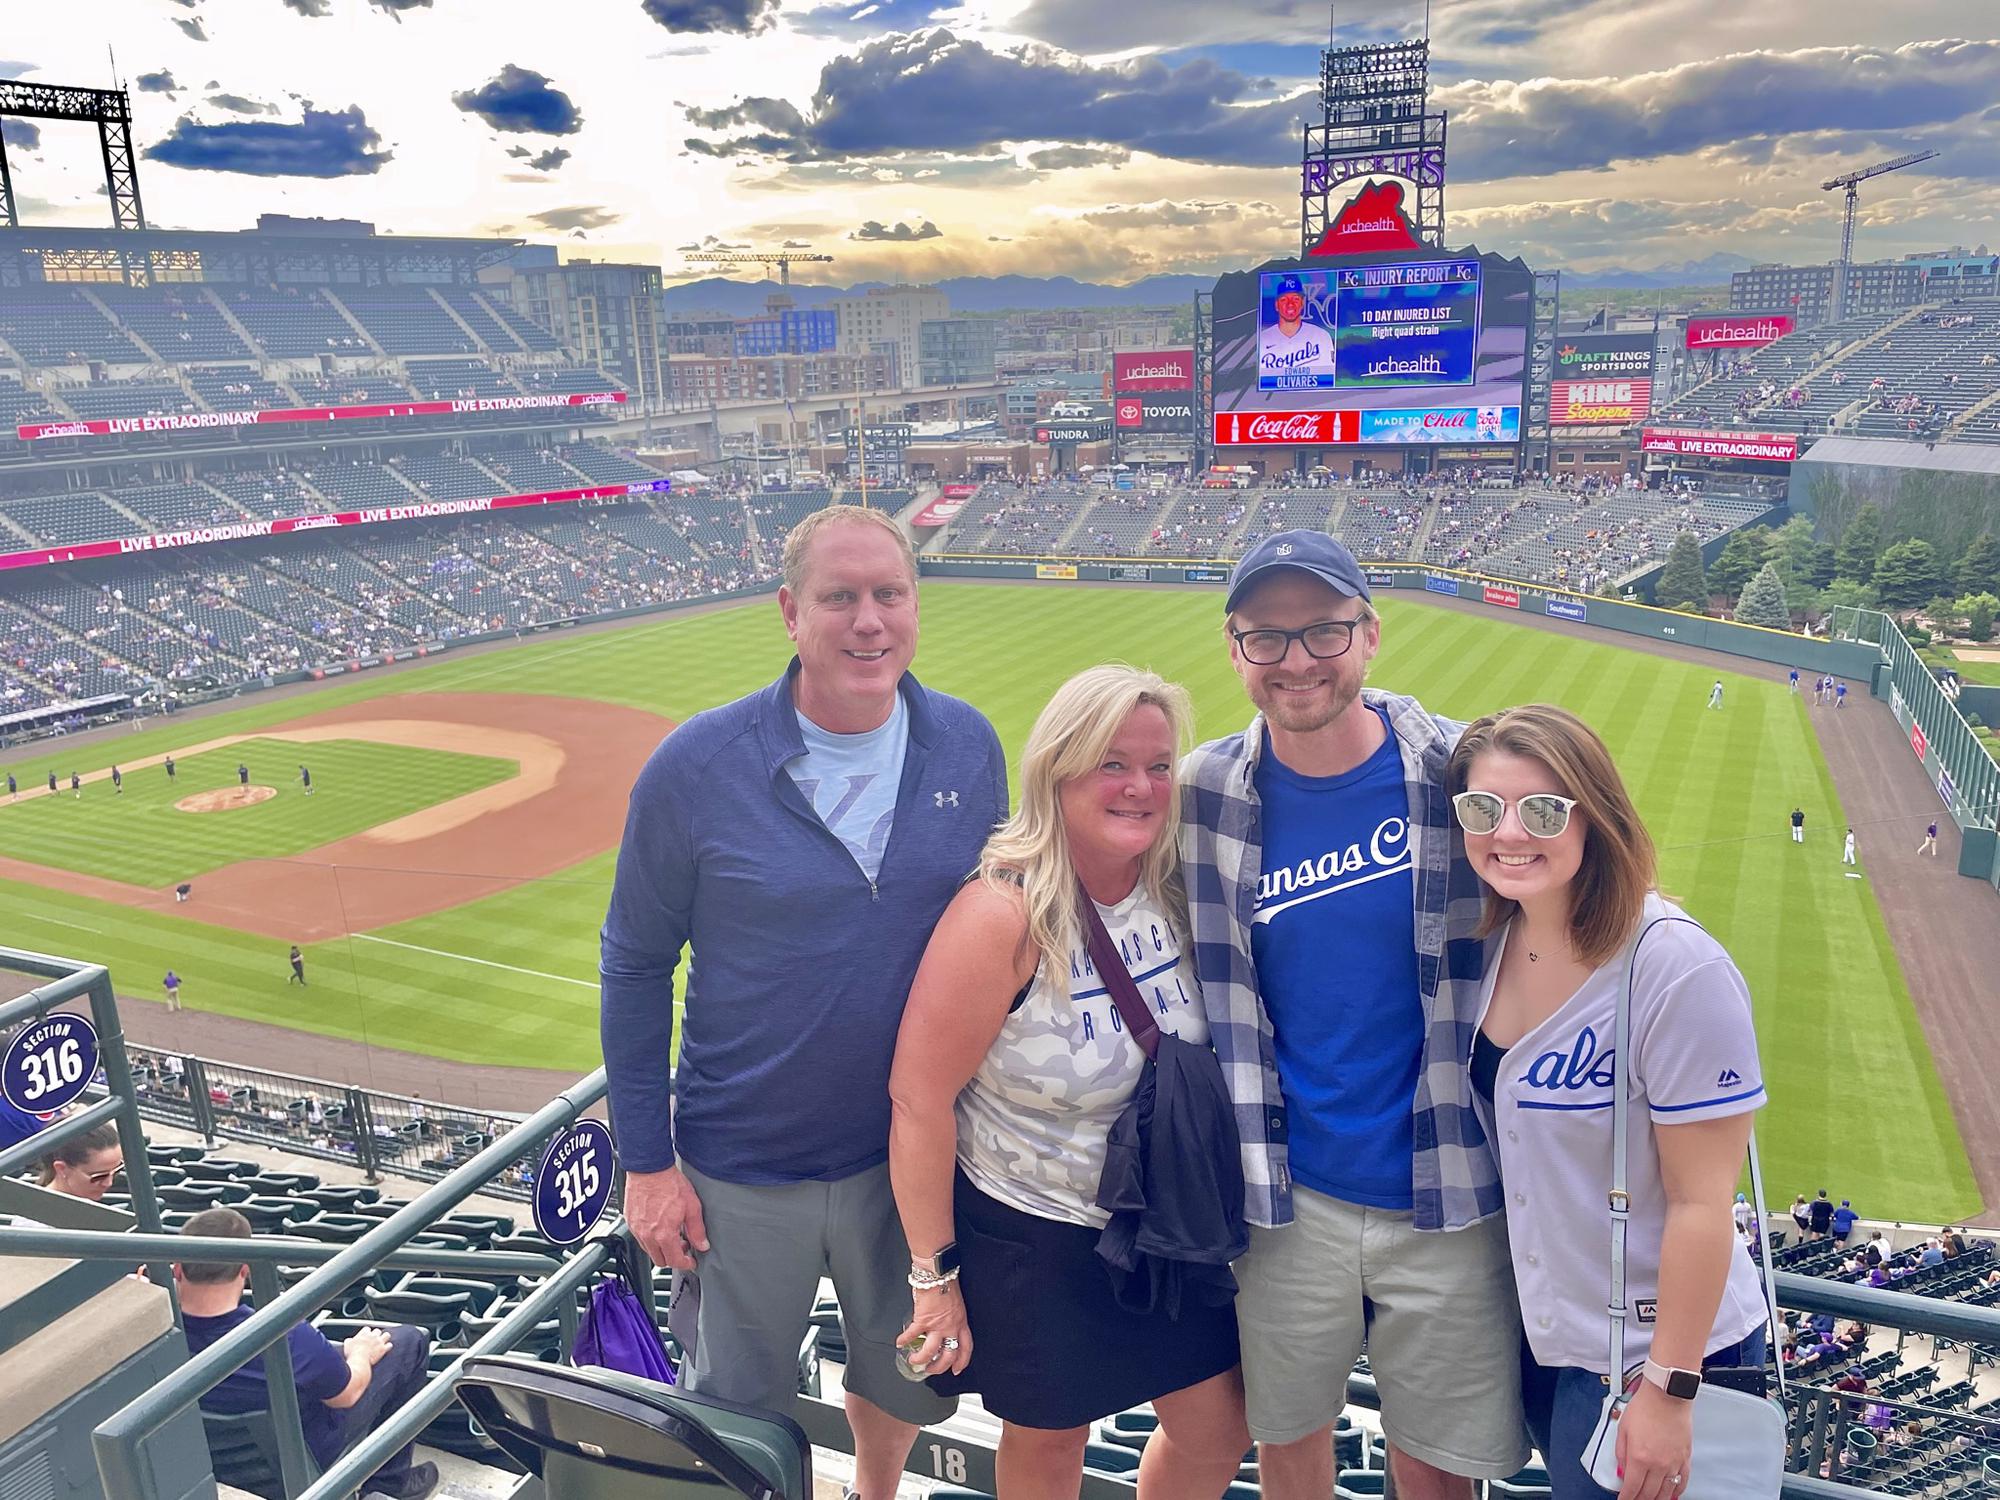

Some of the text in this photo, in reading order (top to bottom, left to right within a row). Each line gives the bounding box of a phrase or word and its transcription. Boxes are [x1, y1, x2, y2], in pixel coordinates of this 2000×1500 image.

[1303, 150, 1445, 193] ROCKIES
[1342, 216, 1395, 234] uchealth
[1365, 266, 1451, 285] INJURY REPORT
[1362, 307, 1451, 322] 10 DAY INJURED LIST
[1372, 325, 1439, 339] Right quad strain
[1701, 320, 1779, 341] uchealth
[1262, 341, 1320, 368] Royals
[1368, 354, 1441, 374] uchealth
[1560, 351, 1651, 365] DRAFTKINGS
[1127, 362, 1182, 378] uchealth
[1581, 362, 1649, 371] SPORTSBOOK
[1277, 375, 1318, 388] OLIVARES
[452, 395, 571, 412] LIVE EXTRAORDINARY
[1568, 384, 1632, 403] KING
[1143, 406, 1192, 417] TOYOTA
[1374, 411, 1469, 428] MADE TO Chill
[1565, 403, 1633, 422] Soopers
[39, 422, 89, 437] uchealth
[108, 411, 261, 433] LIVE EXTRAORDINARY
[1249, 414, 1322, 439] Coca-Cola
[1048, 430, 1089, 439] TUNDRA
[1681, 441, 1793, 458] LIVE EXTRAORDINARY
[360, 498, 493, 523] LIVE EXTRAORDINARY
[120, 521, 274, 553] LIVE EXTRAORDINARY
[1254, 844, 1370, 904] ansas
[1070, 933, 1143, 978] KAAS
[1083, 972, 1202, 1041] ROAL
[22, 1023, 71, 1052] SECTION
[21, 1038, 83, 1100] 316
[553, 1133, 593, 1169] SECTION
[555, 1148, 599, 1218] 315
[578, 1210, 587, 1230] L
[929, 1444, 967, 1484] 18
